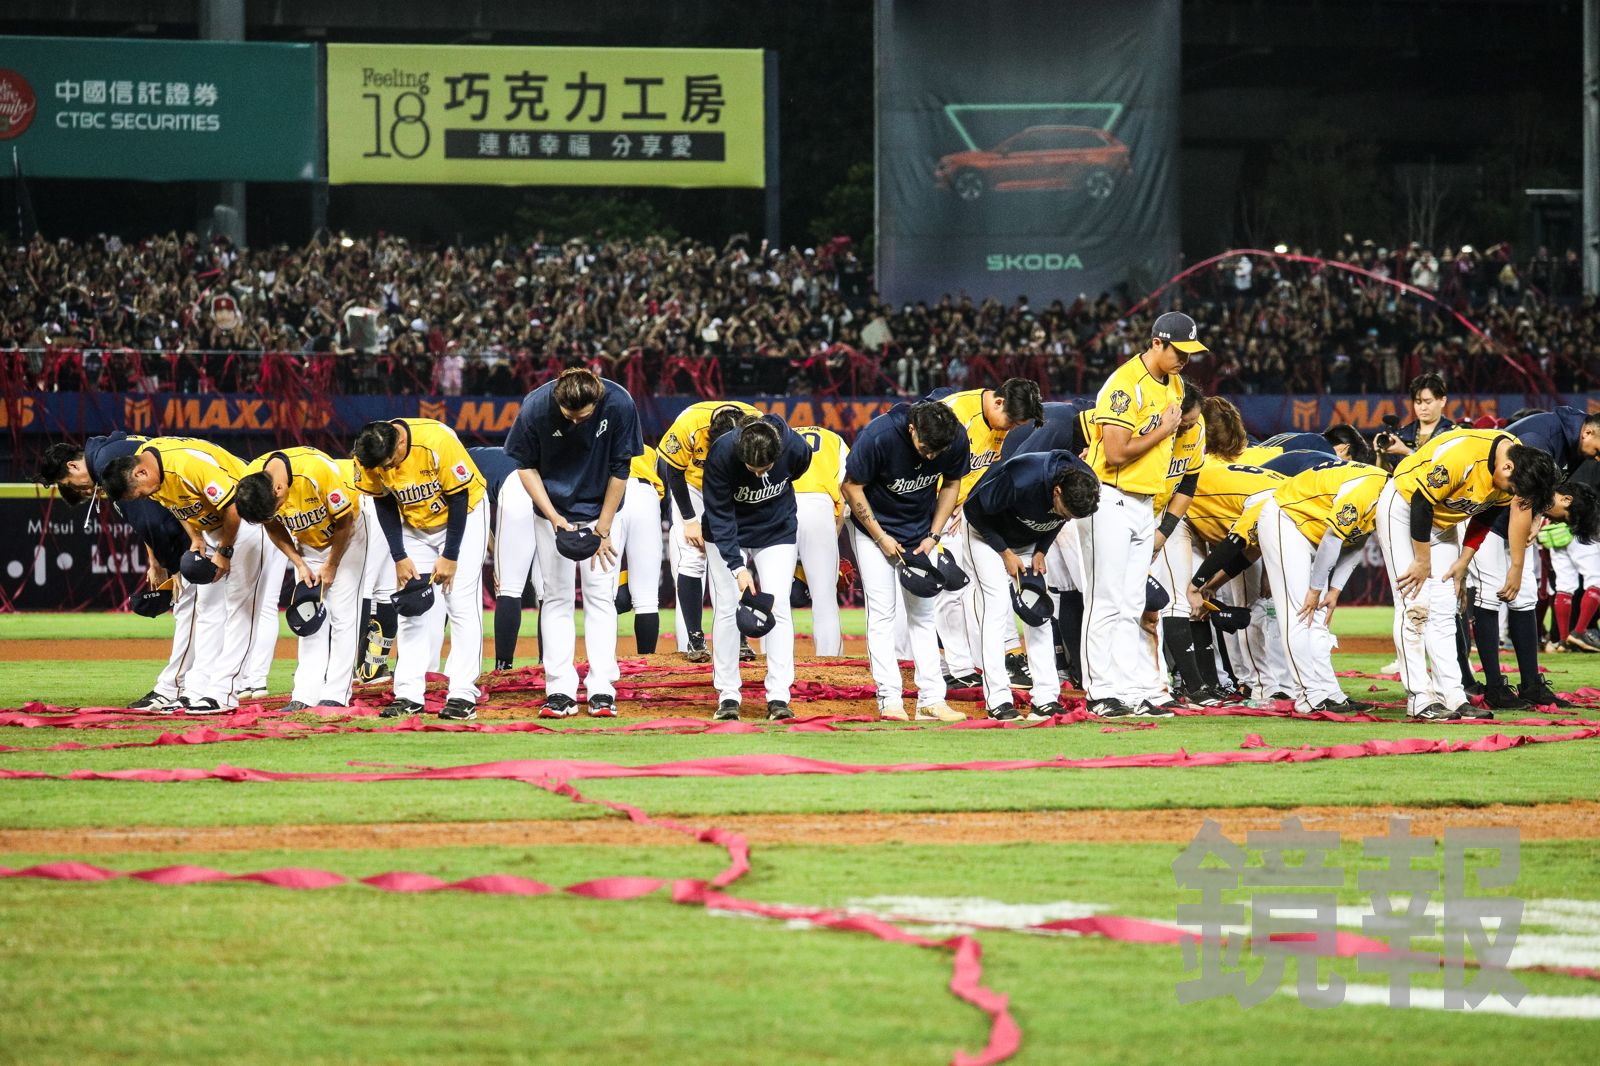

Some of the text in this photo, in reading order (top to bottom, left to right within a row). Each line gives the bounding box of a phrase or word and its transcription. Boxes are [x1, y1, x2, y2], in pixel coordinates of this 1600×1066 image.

[55, 80, 218, 107] 中國信託證券
[362, 67, 430, 96] Feeling
[444, 71, 726, 124] 巧克力工房
[55, 111, 220, 132] CTBC SECURITIES
[362, 91, 430, 159] 18
[478, 133, 693, 158] 連結幸福 分享愛
